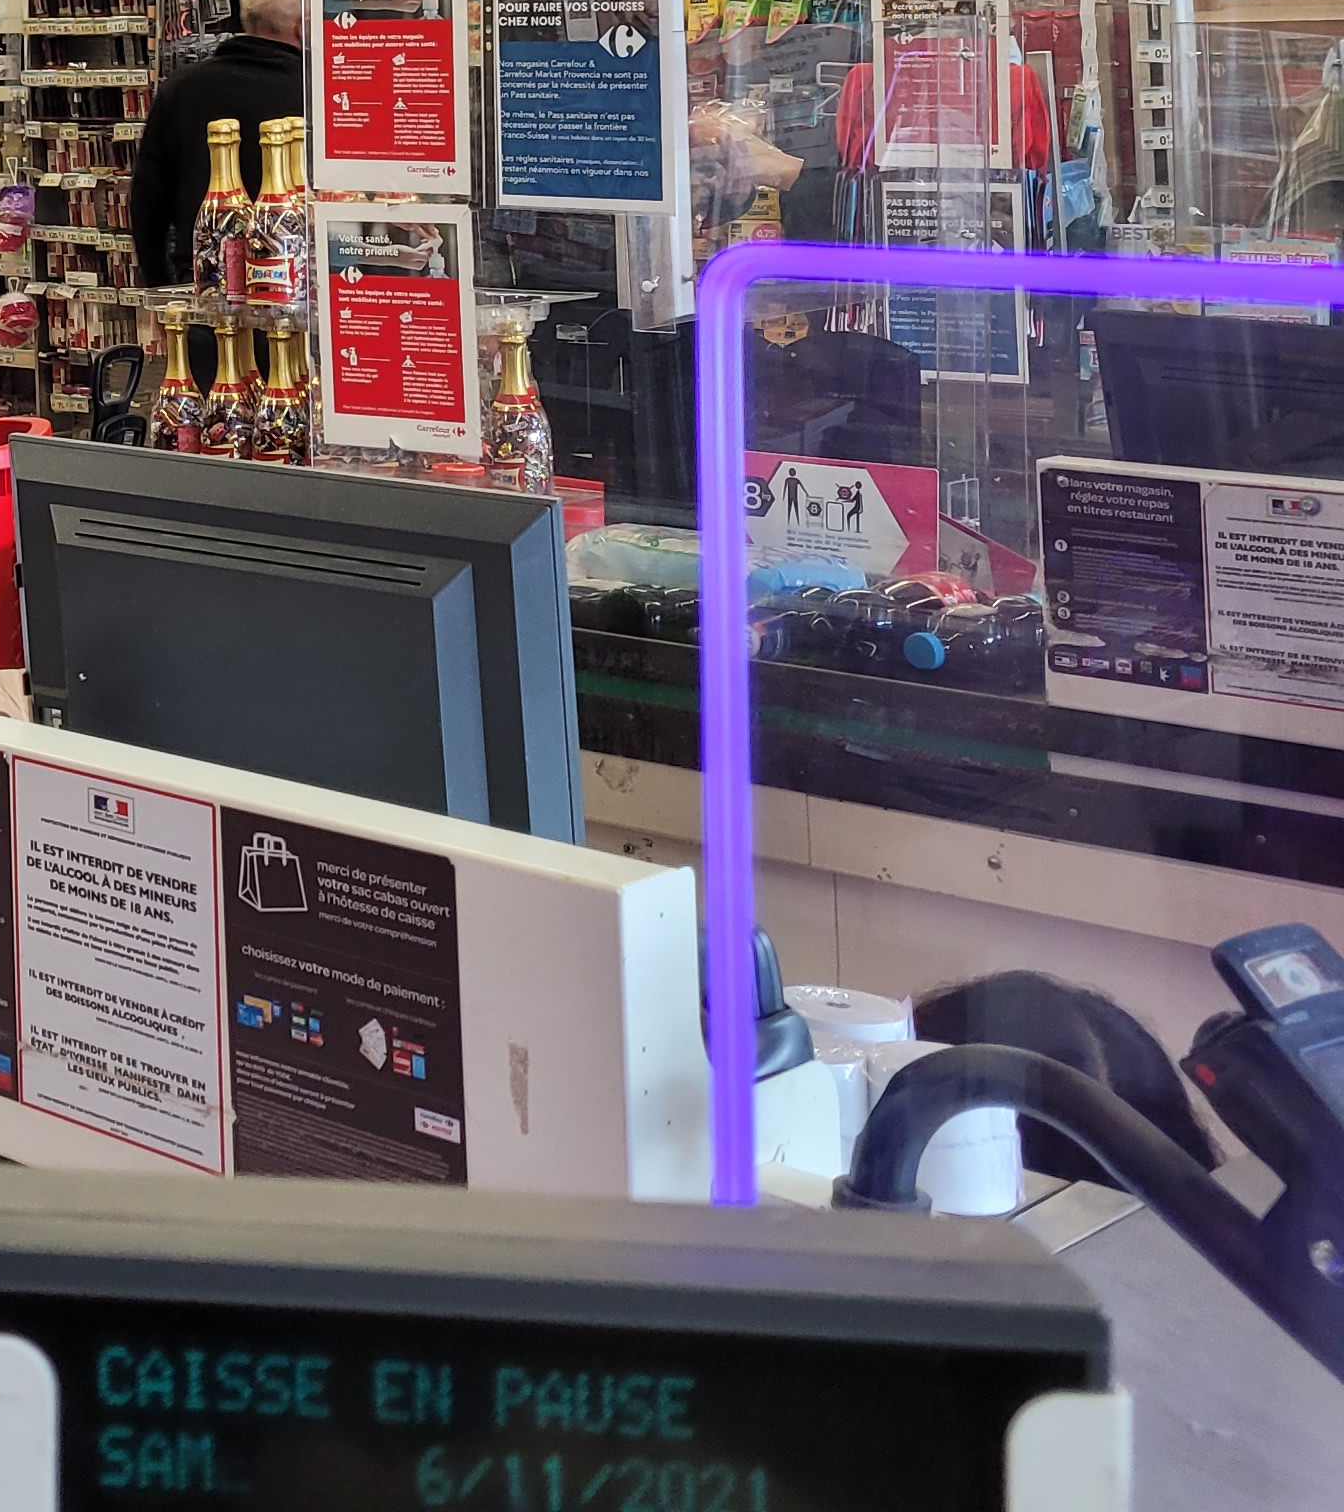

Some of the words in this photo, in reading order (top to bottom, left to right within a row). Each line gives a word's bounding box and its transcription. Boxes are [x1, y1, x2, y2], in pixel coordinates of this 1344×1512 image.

[499, 3, 530, 12] POUR
[533, 3, 562, 12] FAIRE
[565, 2, 588, 11] VOS
[591, 2, 645, 12] COURSES
[499, 17, 528, 26] CHEZ
[531, 16, 562, 26] NOUS
[516, 60, 548, 70] magasins
[551, 60, 586, 68] Carrefour
[27, 855, 42, 869] DE
[102, 874, 111, 889] À
[114, 880, 136, 896] DES
[139, 887, 197, 913] MINEURS
[30, 840, 41, 853] IL
[43, 844, 64, 858] EST
[66, 849, 124, 875] INTERDIT
[127, 867, 143, 880] DE
[145, 871, 197, 896] VENDRE
[317, 860, 350, 877] merci
[352, 867, 366, 881] de
[368, 874, 427, 896] présenter
[50, 879, 65, 893] DE
[68, 883, 108, 904] MOINS
[111, 896, 126, 910] DE
[130, 902, 141, 914] 18
[317, 877, 350, 892] votre
[352, 884, 371, 898] sac
[373, 889, 409, 907] cabas
[410, 899, 451, 918] ouvert
[318, 890, 326, 903] à
[381, 907, 396, 920] de
[398, 912, 435, 930] caisse
[242, 944, 298, 968] choisissez
[299, 959, 330, 978] votre
[332, 969, 364, 987] mode
[367, 977, 381, 992] de
[383, 981, 440, 1009] paiement
[96, 1345, 333, 1419] CAISSE
[374, 1358, 453, 1425] EN
[493, 1365, 697, 1439] PAUSE
